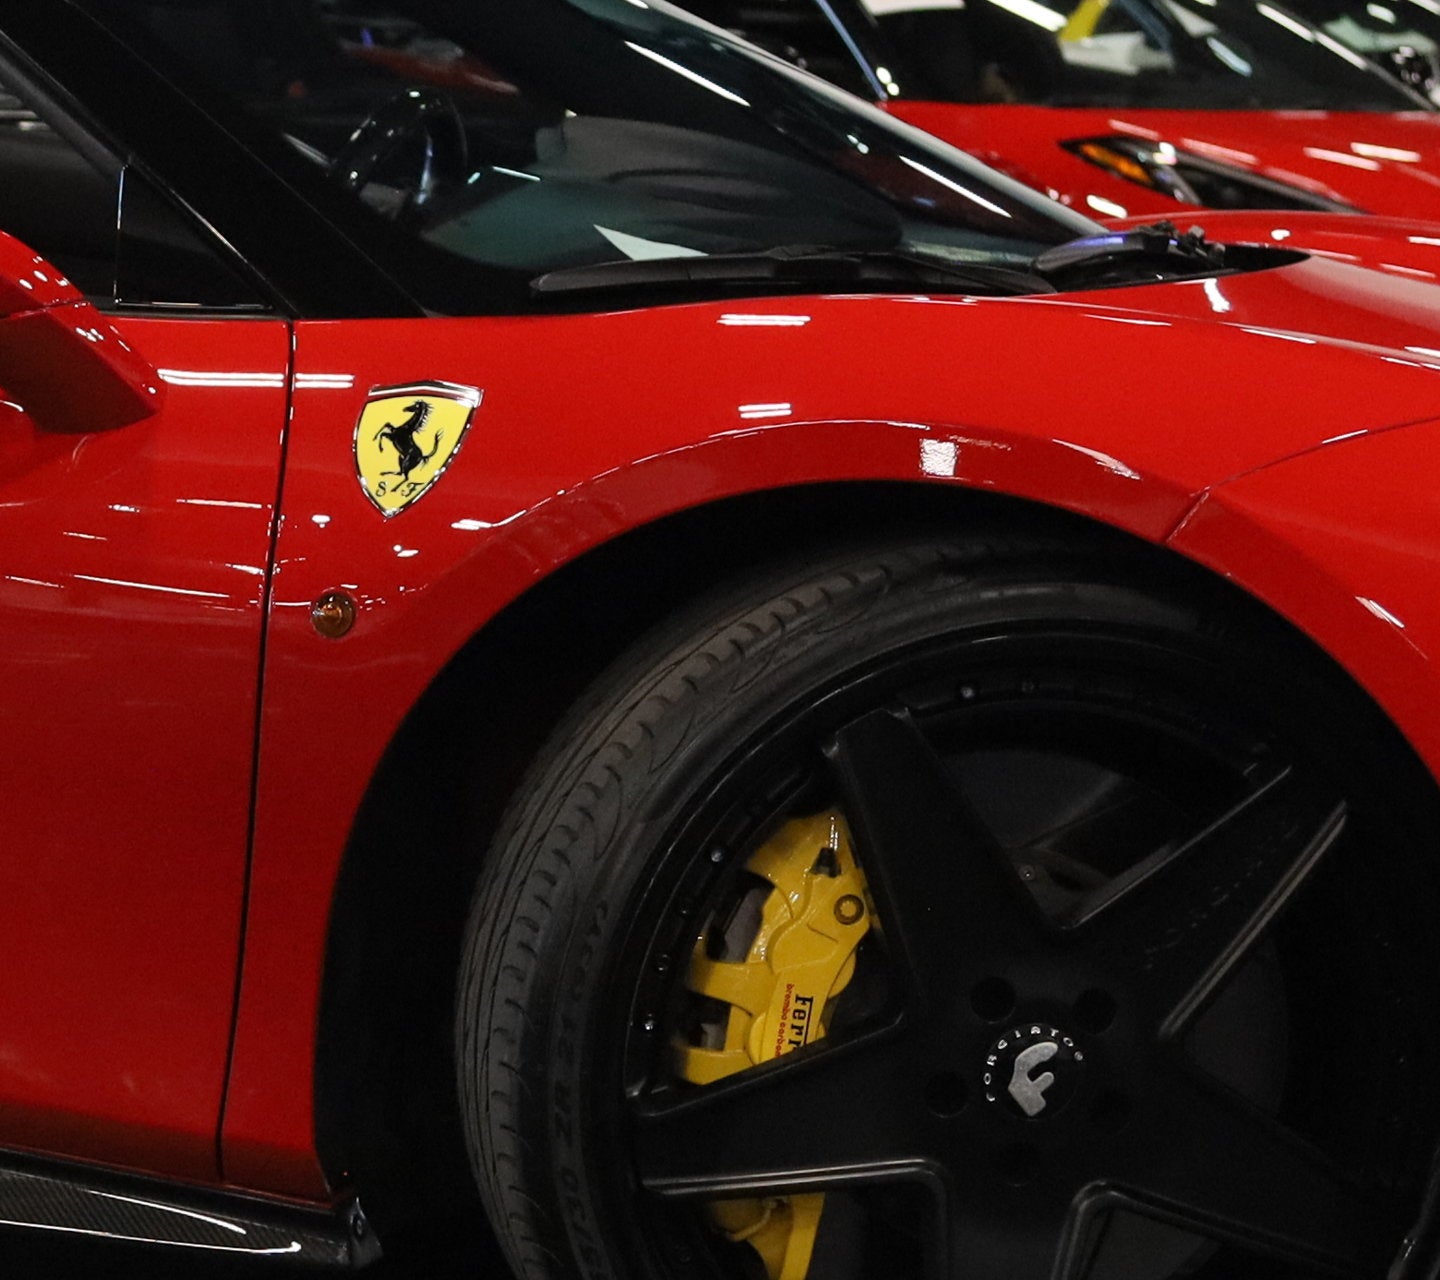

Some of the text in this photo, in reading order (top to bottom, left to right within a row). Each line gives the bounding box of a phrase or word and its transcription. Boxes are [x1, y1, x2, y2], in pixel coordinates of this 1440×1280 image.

[375, 481, 386, 497] S
[781, 983, 795, 1021] brembo
[788, 993, 814, 1049] Ferr
